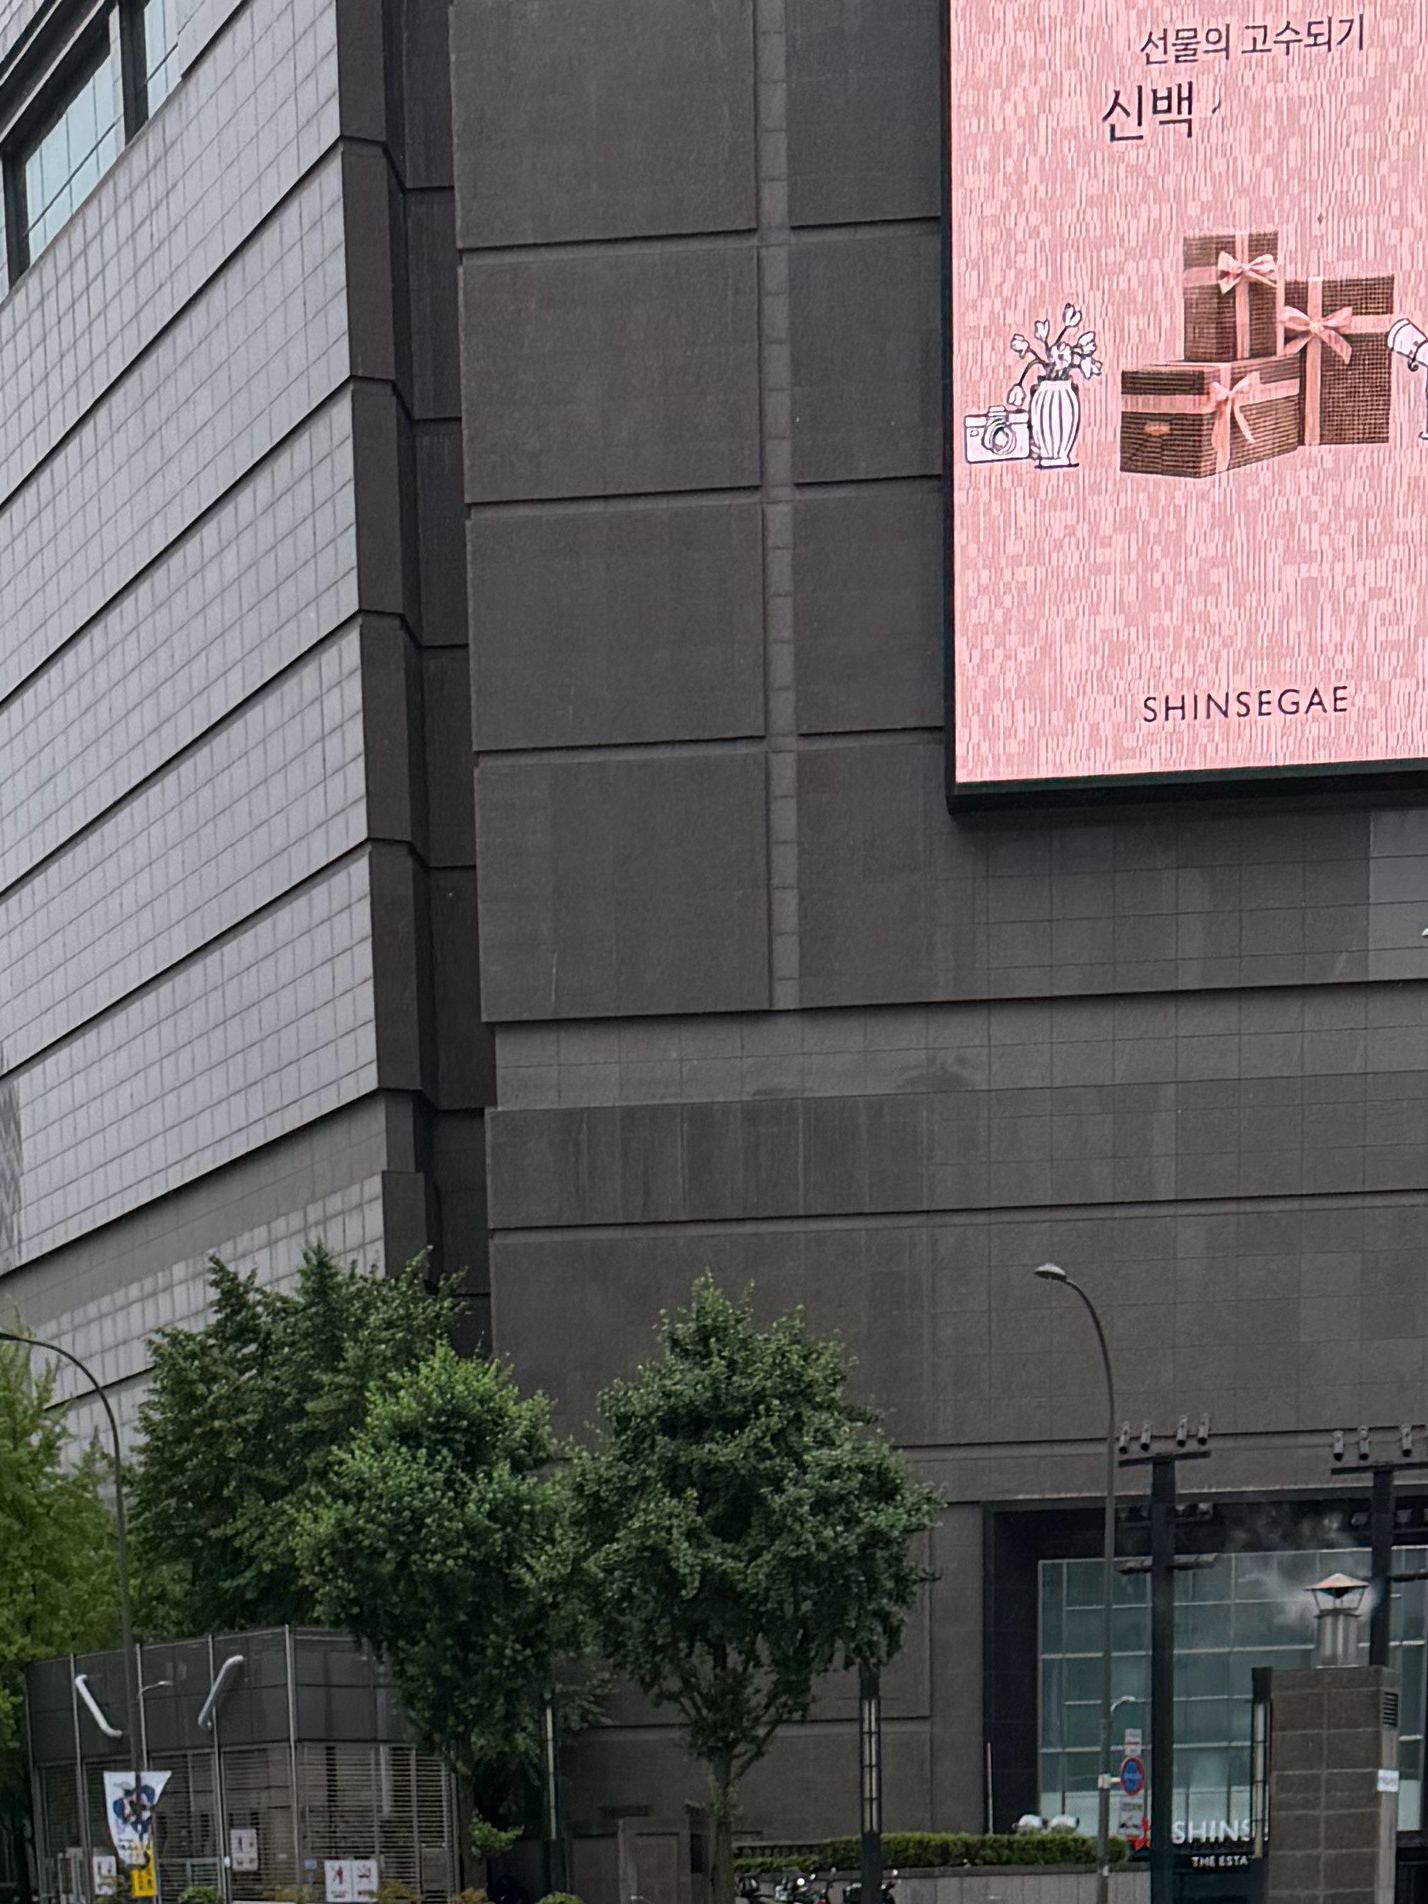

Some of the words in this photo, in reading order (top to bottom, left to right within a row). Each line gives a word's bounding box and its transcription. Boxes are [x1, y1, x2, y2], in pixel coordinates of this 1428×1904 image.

[1139, 23, 1231, 66] 선물의
[1240, 13, 1365, 57] 고수되기
[1101, 80, 1195, 143] 신백
[1142, 685, 1349, 723] SHINSEGAE
[1172, 1817, 1253, 1845] SHINS
[1191, 1856, 1216, 1868] THE
[1218, 1854, 1252, 1868] ESTA
